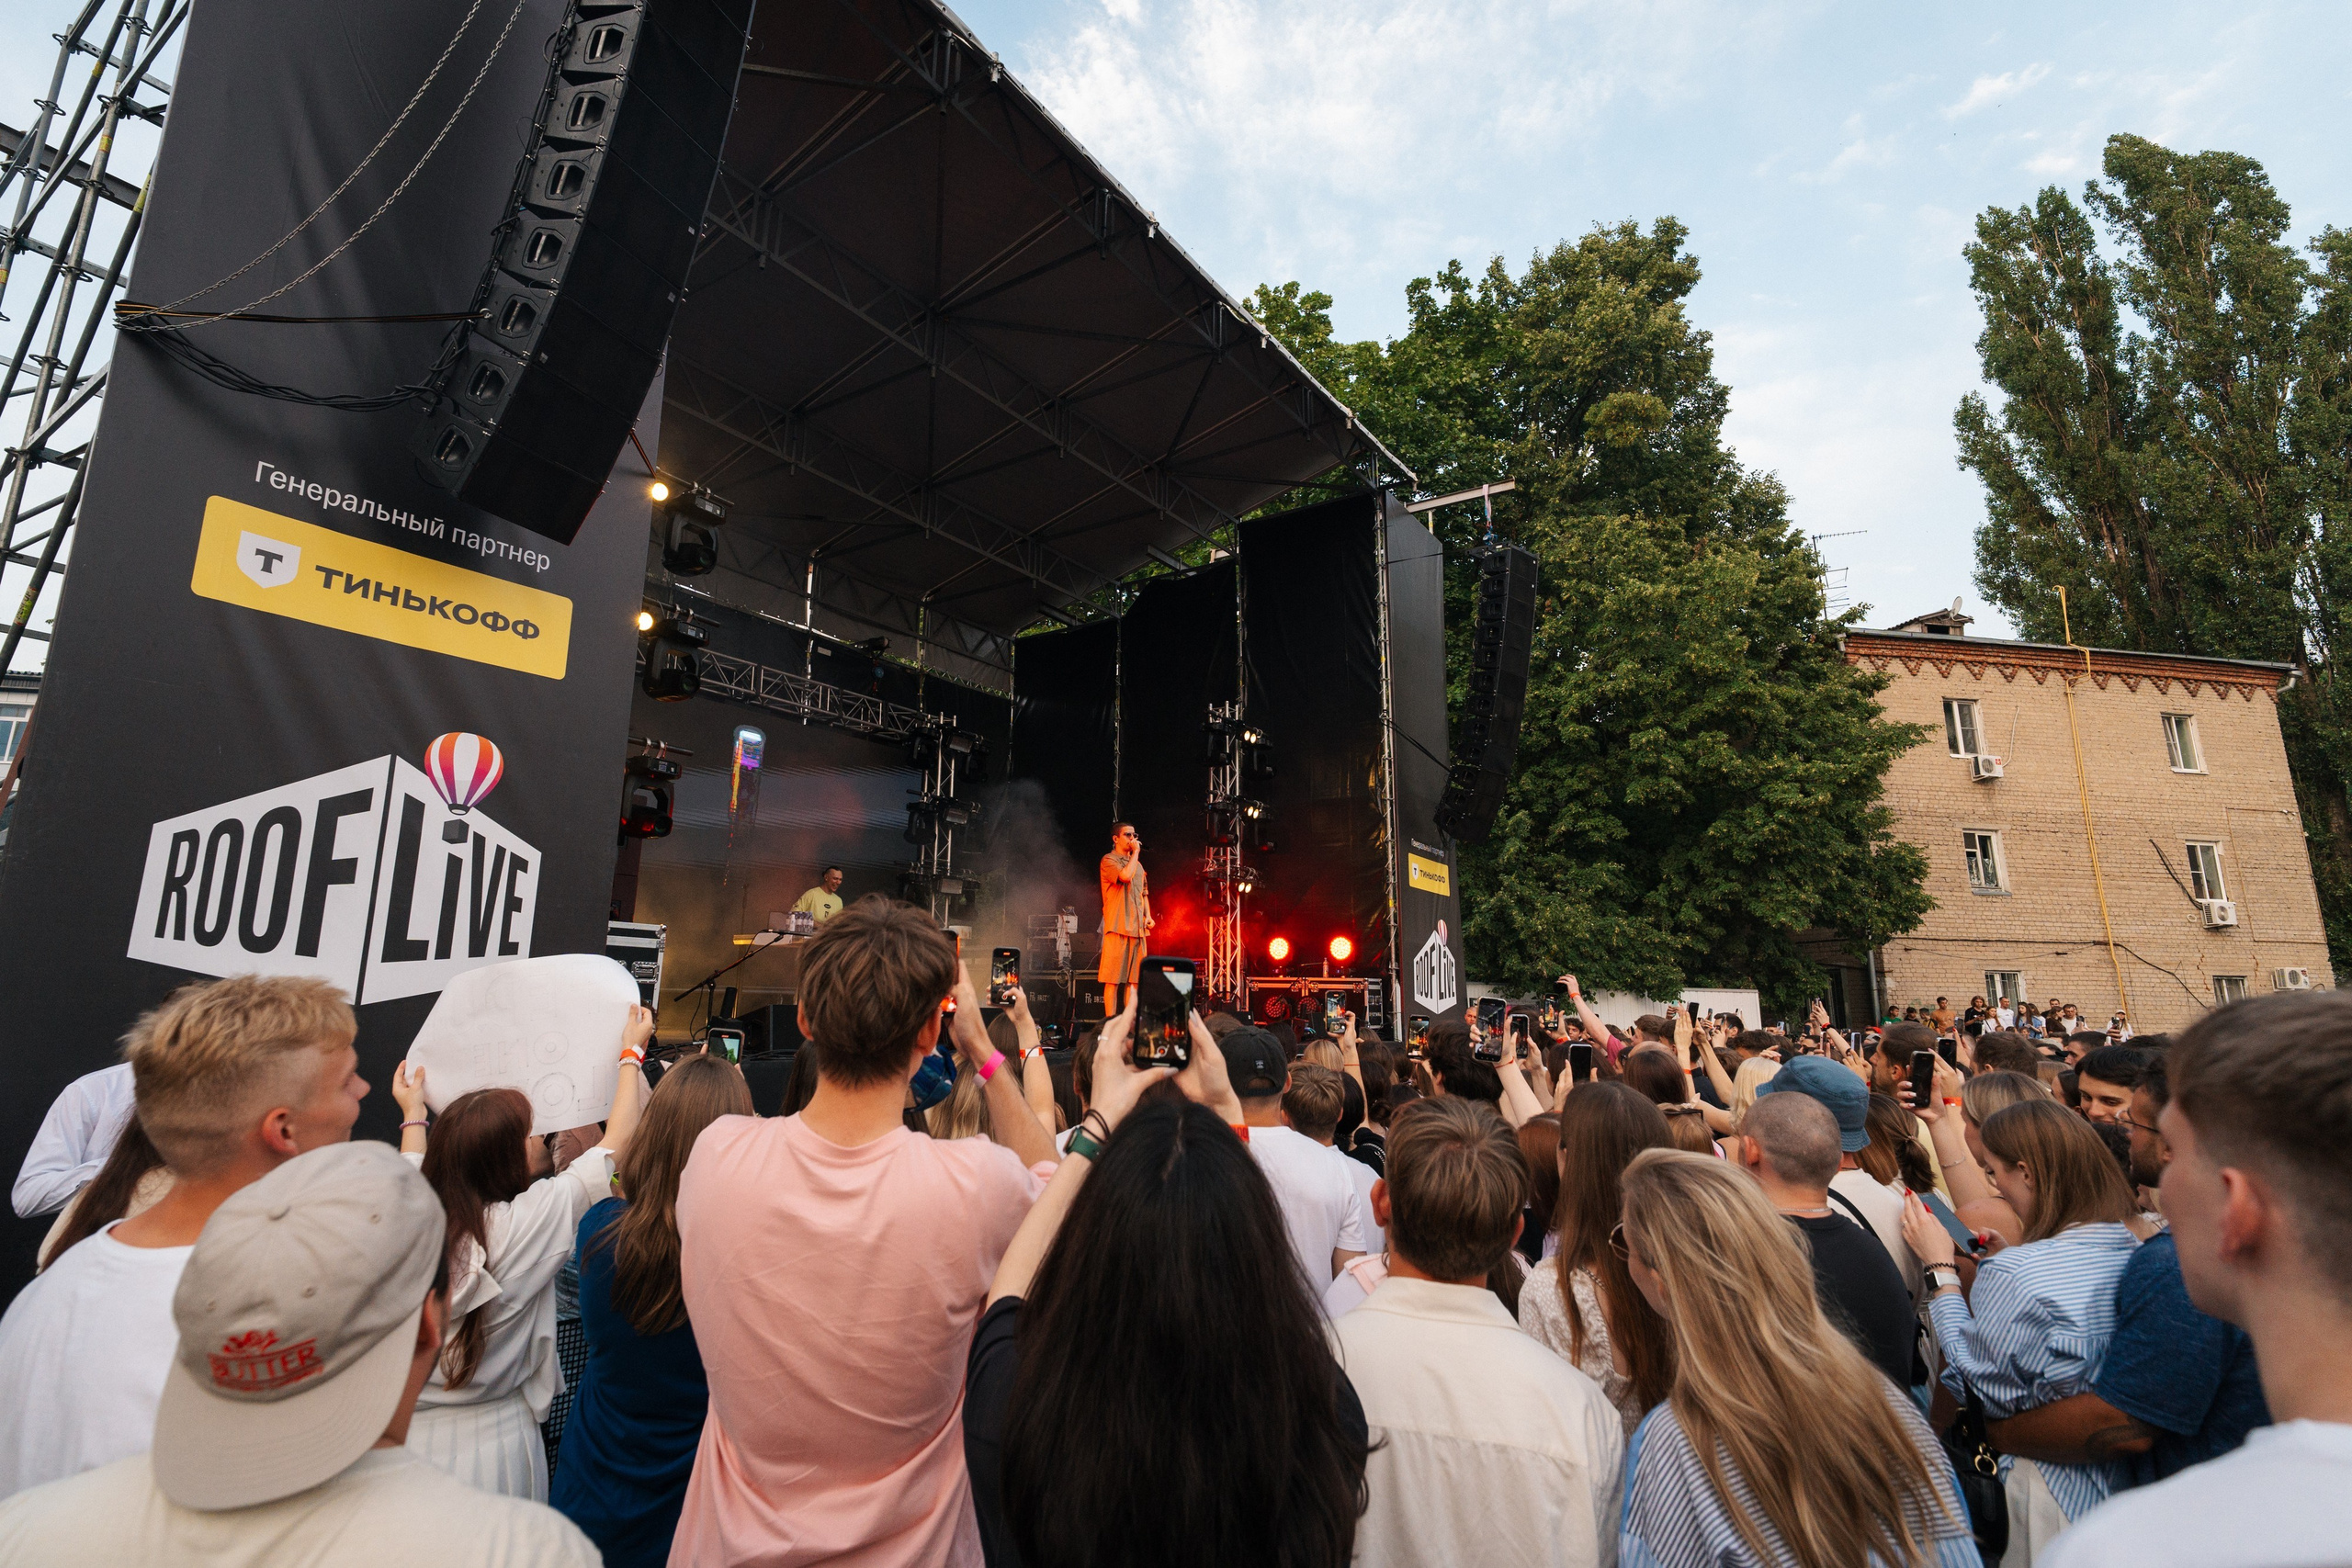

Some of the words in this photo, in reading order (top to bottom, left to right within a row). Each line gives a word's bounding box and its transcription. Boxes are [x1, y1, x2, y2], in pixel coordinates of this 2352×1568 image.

[255, 460, 445, 539] Генеральный
[451, 527, 550, 573] партнер
[315, 565, 540, 640] ТИНЬКОФФ
[154, 787, 375, 959] ROOF
[1416, 942, 1436, 999] ROOF
[209, 1344, 318, 1382] BUTTER
